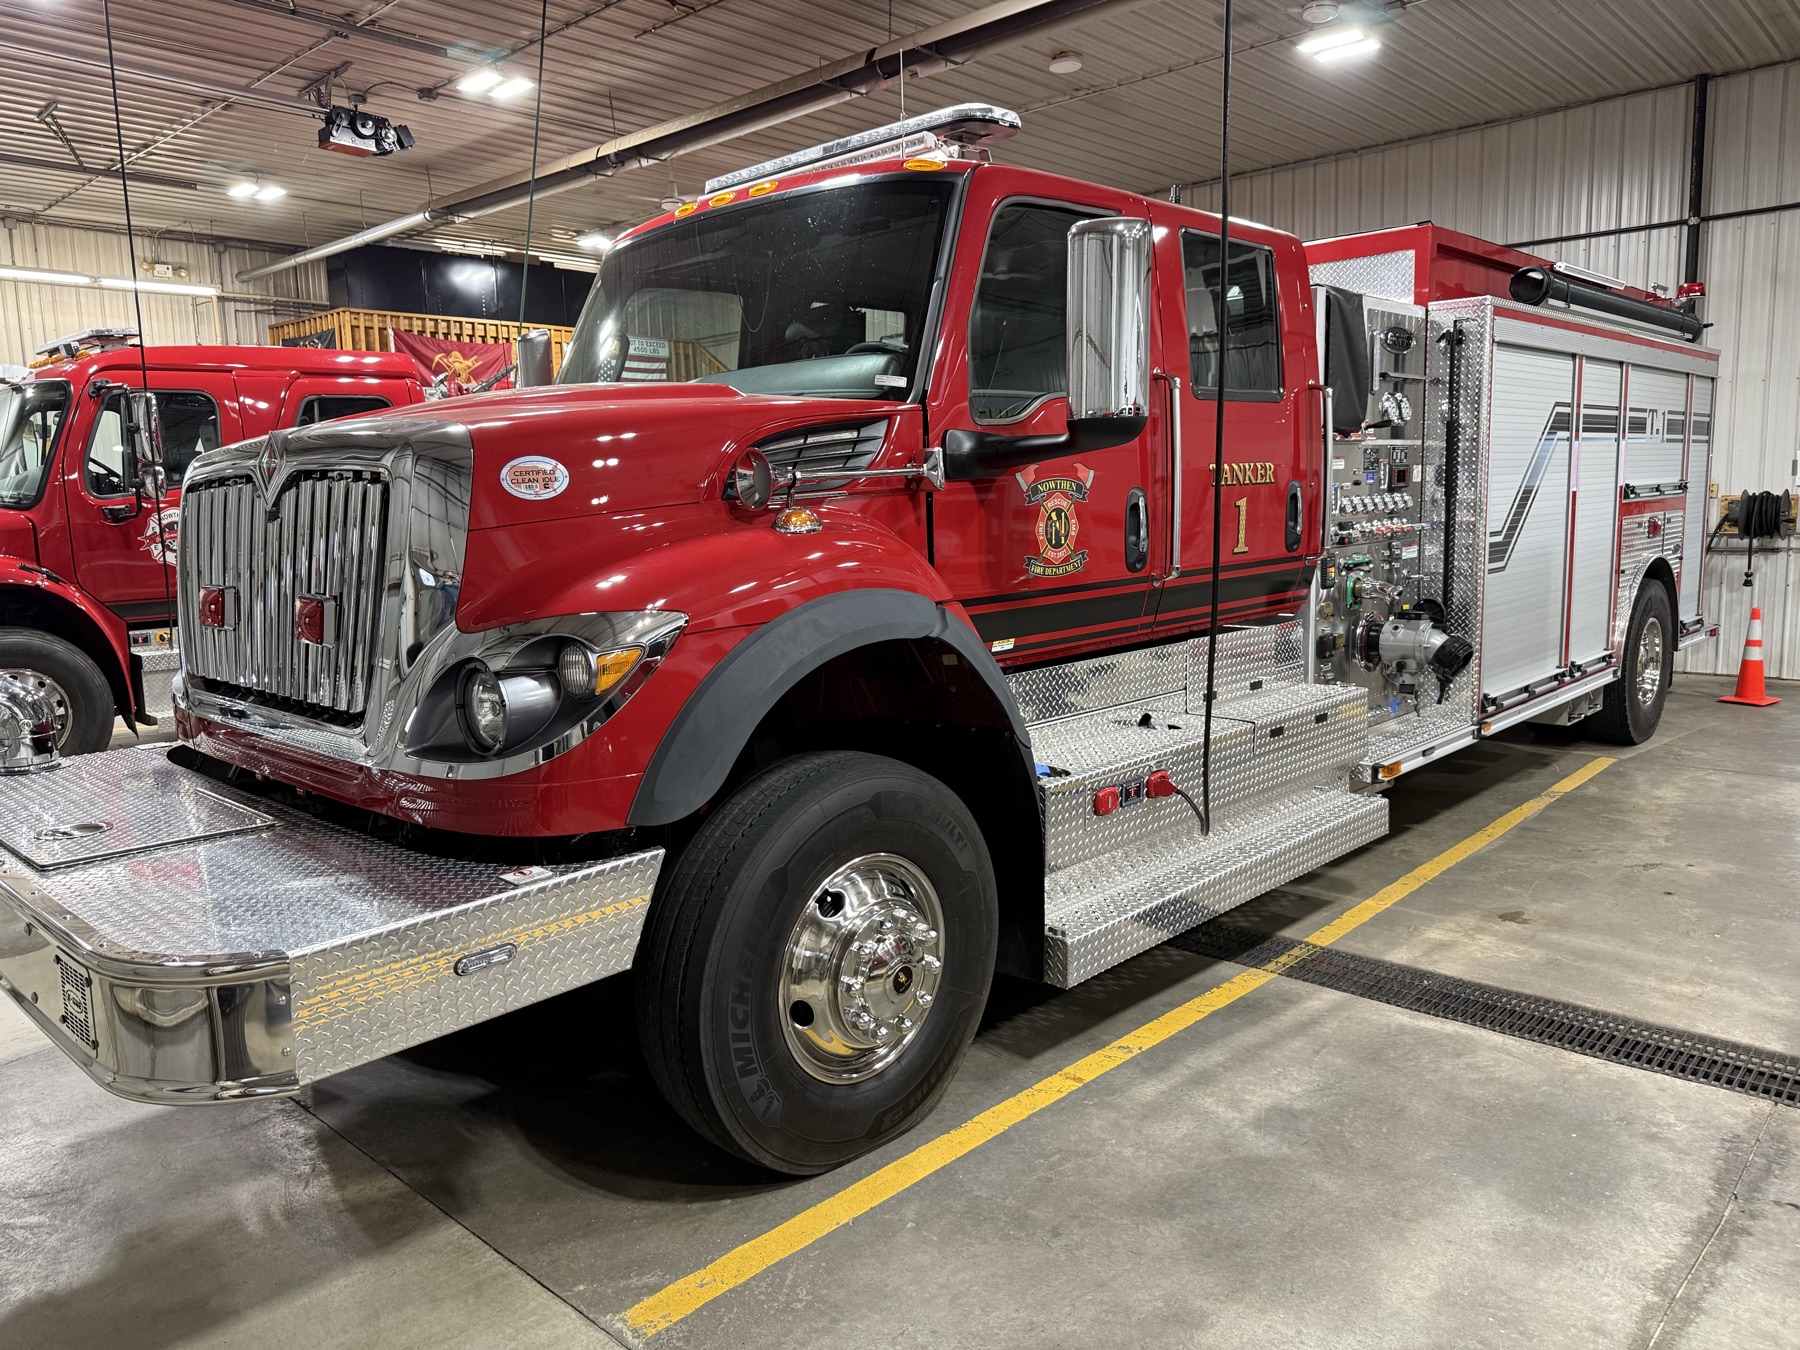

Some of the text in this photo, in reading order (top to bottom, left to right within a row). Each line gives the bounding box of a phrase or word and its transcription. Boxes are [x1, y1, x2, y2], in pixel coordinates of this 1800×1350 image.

[646, 341, 666, 349] EXCEED
[513, 469, 556, 477] CERTIFIED
[511, 477, 539, 485] CLEAN
[1037, 480, 1077, 494] NOWTHEN
[1047, 498, 1068, 508] RESCUE
[1232, 496, 1249, 555] 1
[1031, 560, 1081, 576] FIRE DEPARTMENT
[927, 807, 970, 852] MULTI
